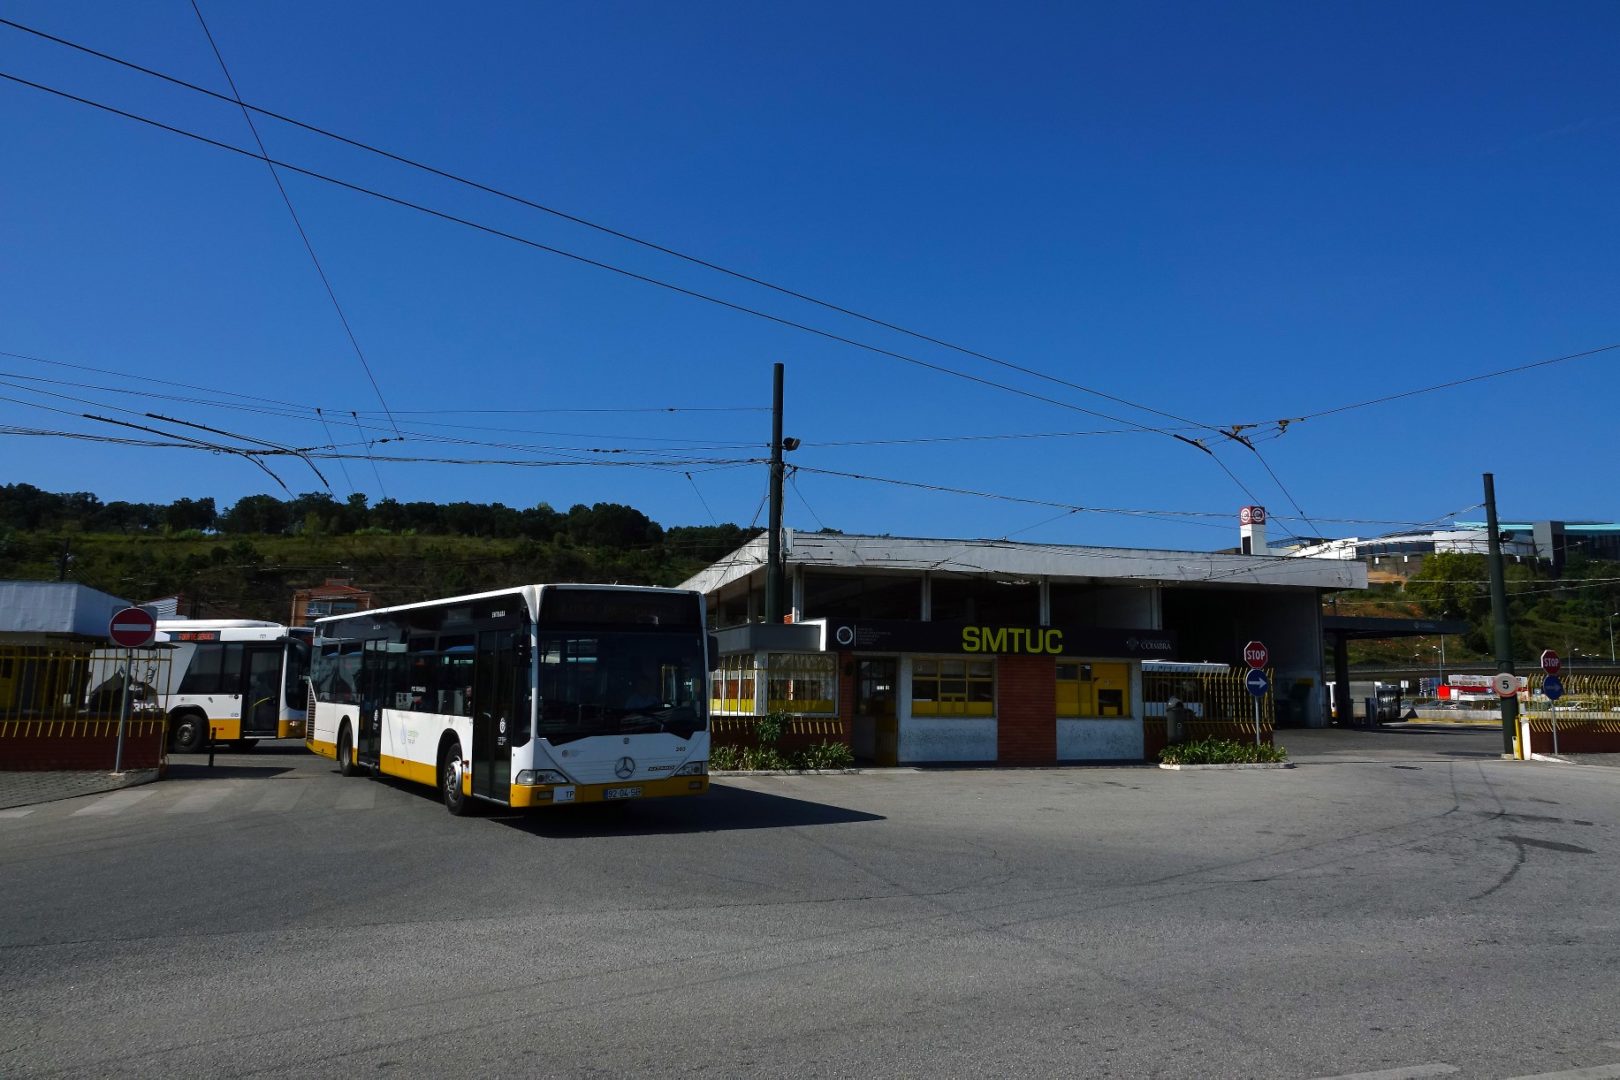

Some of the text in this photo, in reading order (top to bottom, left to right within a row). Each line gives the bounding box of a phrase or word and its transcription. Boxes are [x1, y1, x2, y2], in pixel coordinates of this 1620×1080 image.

[962, 626, 1064, 654] SMTUC
[1246, 650, 1266, 661] STOP
[1543, 657, 1560, 667] STOP
[1502, 680, 1510, 689] 5
[565, 790, 575, 798] TP
